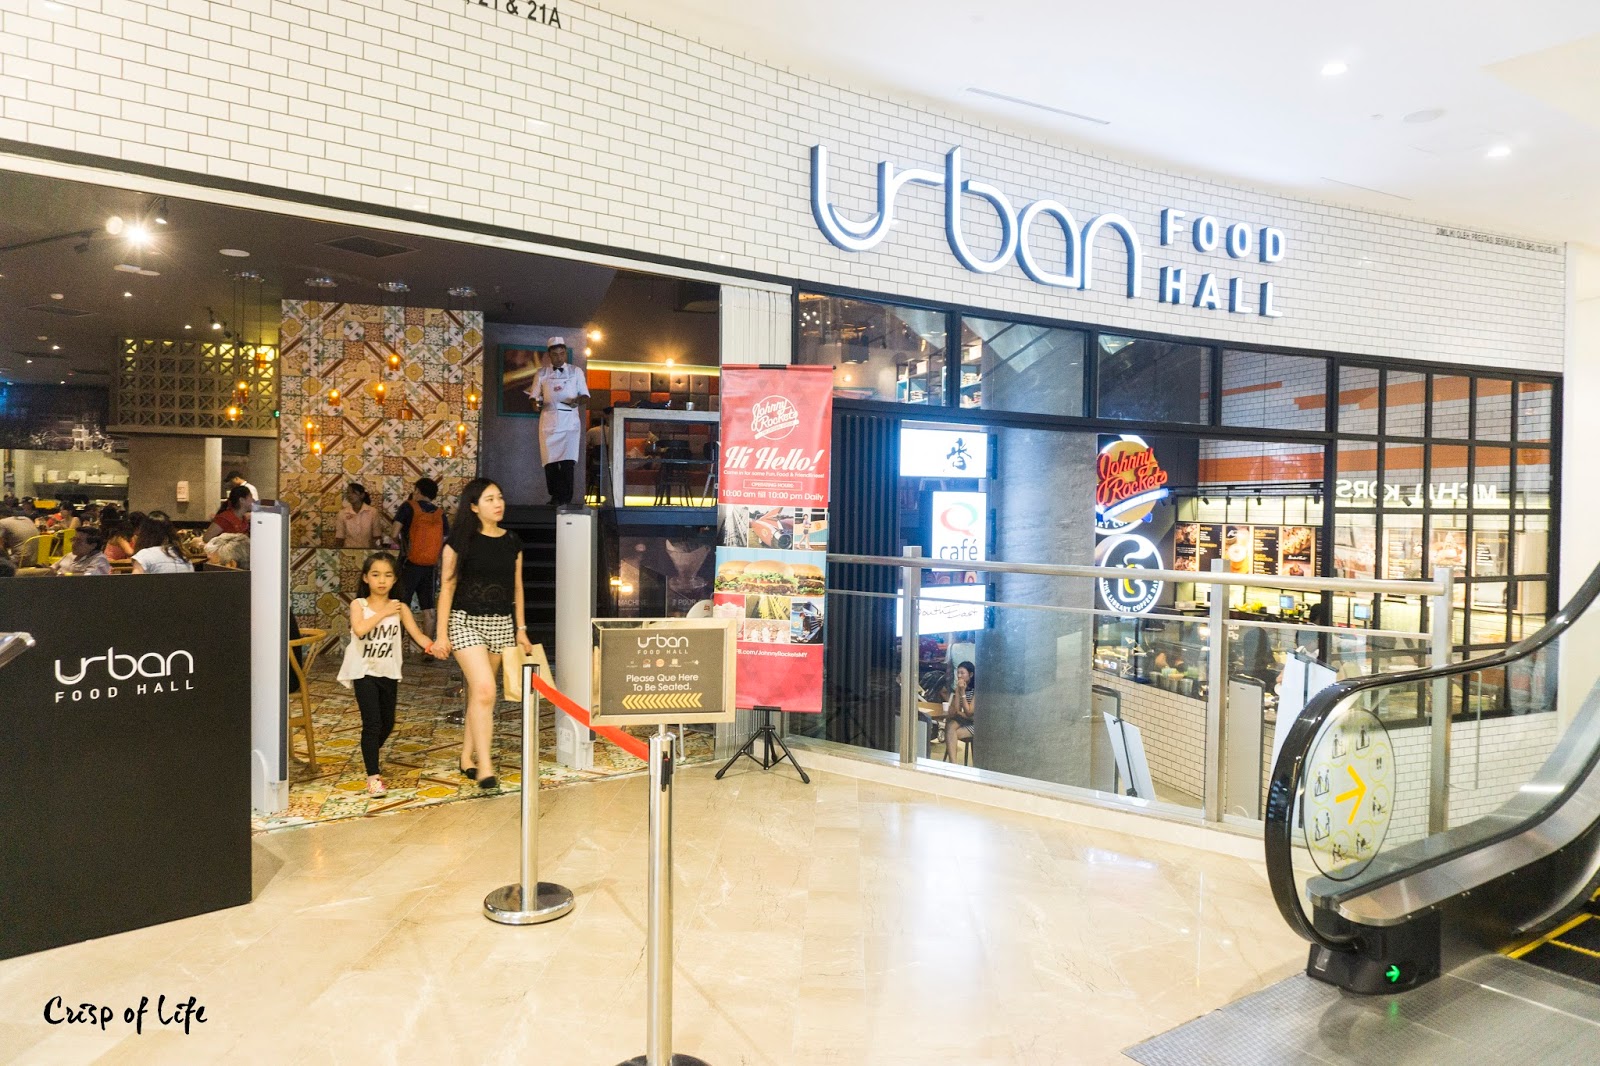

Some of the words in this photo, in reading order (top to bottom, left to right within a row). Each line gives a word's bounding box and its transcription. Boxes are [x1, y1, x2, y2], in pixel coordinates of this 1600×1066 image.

[527, 0, 562, 29] 21A
[810, 144, 1142, 298] urban
[1160, 208, 1286, 264] FOOD
[1159, 265, 1284, 317] HALL
[751, 399, 791, 430] Johnny
[757, 409, 798, 433] Rockets
[724, 445, 754, 469] Hi
[754, 447, 825, 472] Hello!
[1097, 447, 1158, 496] Johnny
[722, 489, 742, 497] 10:00
[768, 491, 789, 499] 10:00
[789, 493, 803, 501] pm
[804, 493, 824, 502] Daily
[1105, 465, 1168, 507] Rockets
[939, 538, 979, 561] café
[918, 603, 978, 619] outhEast
[1108, 594, 1131, 612] LIBRARY
[1132, 593, 1153, 612] COFFEE
[637, 633, 689, 648] urban
[54, 646, 194, 685] urban
[626, 674, 655, 682] Please
[657, 673, 676, 682] Que
[678, 673, 699, 681] Here
[55, 686, 118, 703] FOOD
[137, 679, 194, 695] HALL
[632, 684, 643, 692] To
[645, 683, 656, 691] Be
[657, 682, 692, 691] Seated.
